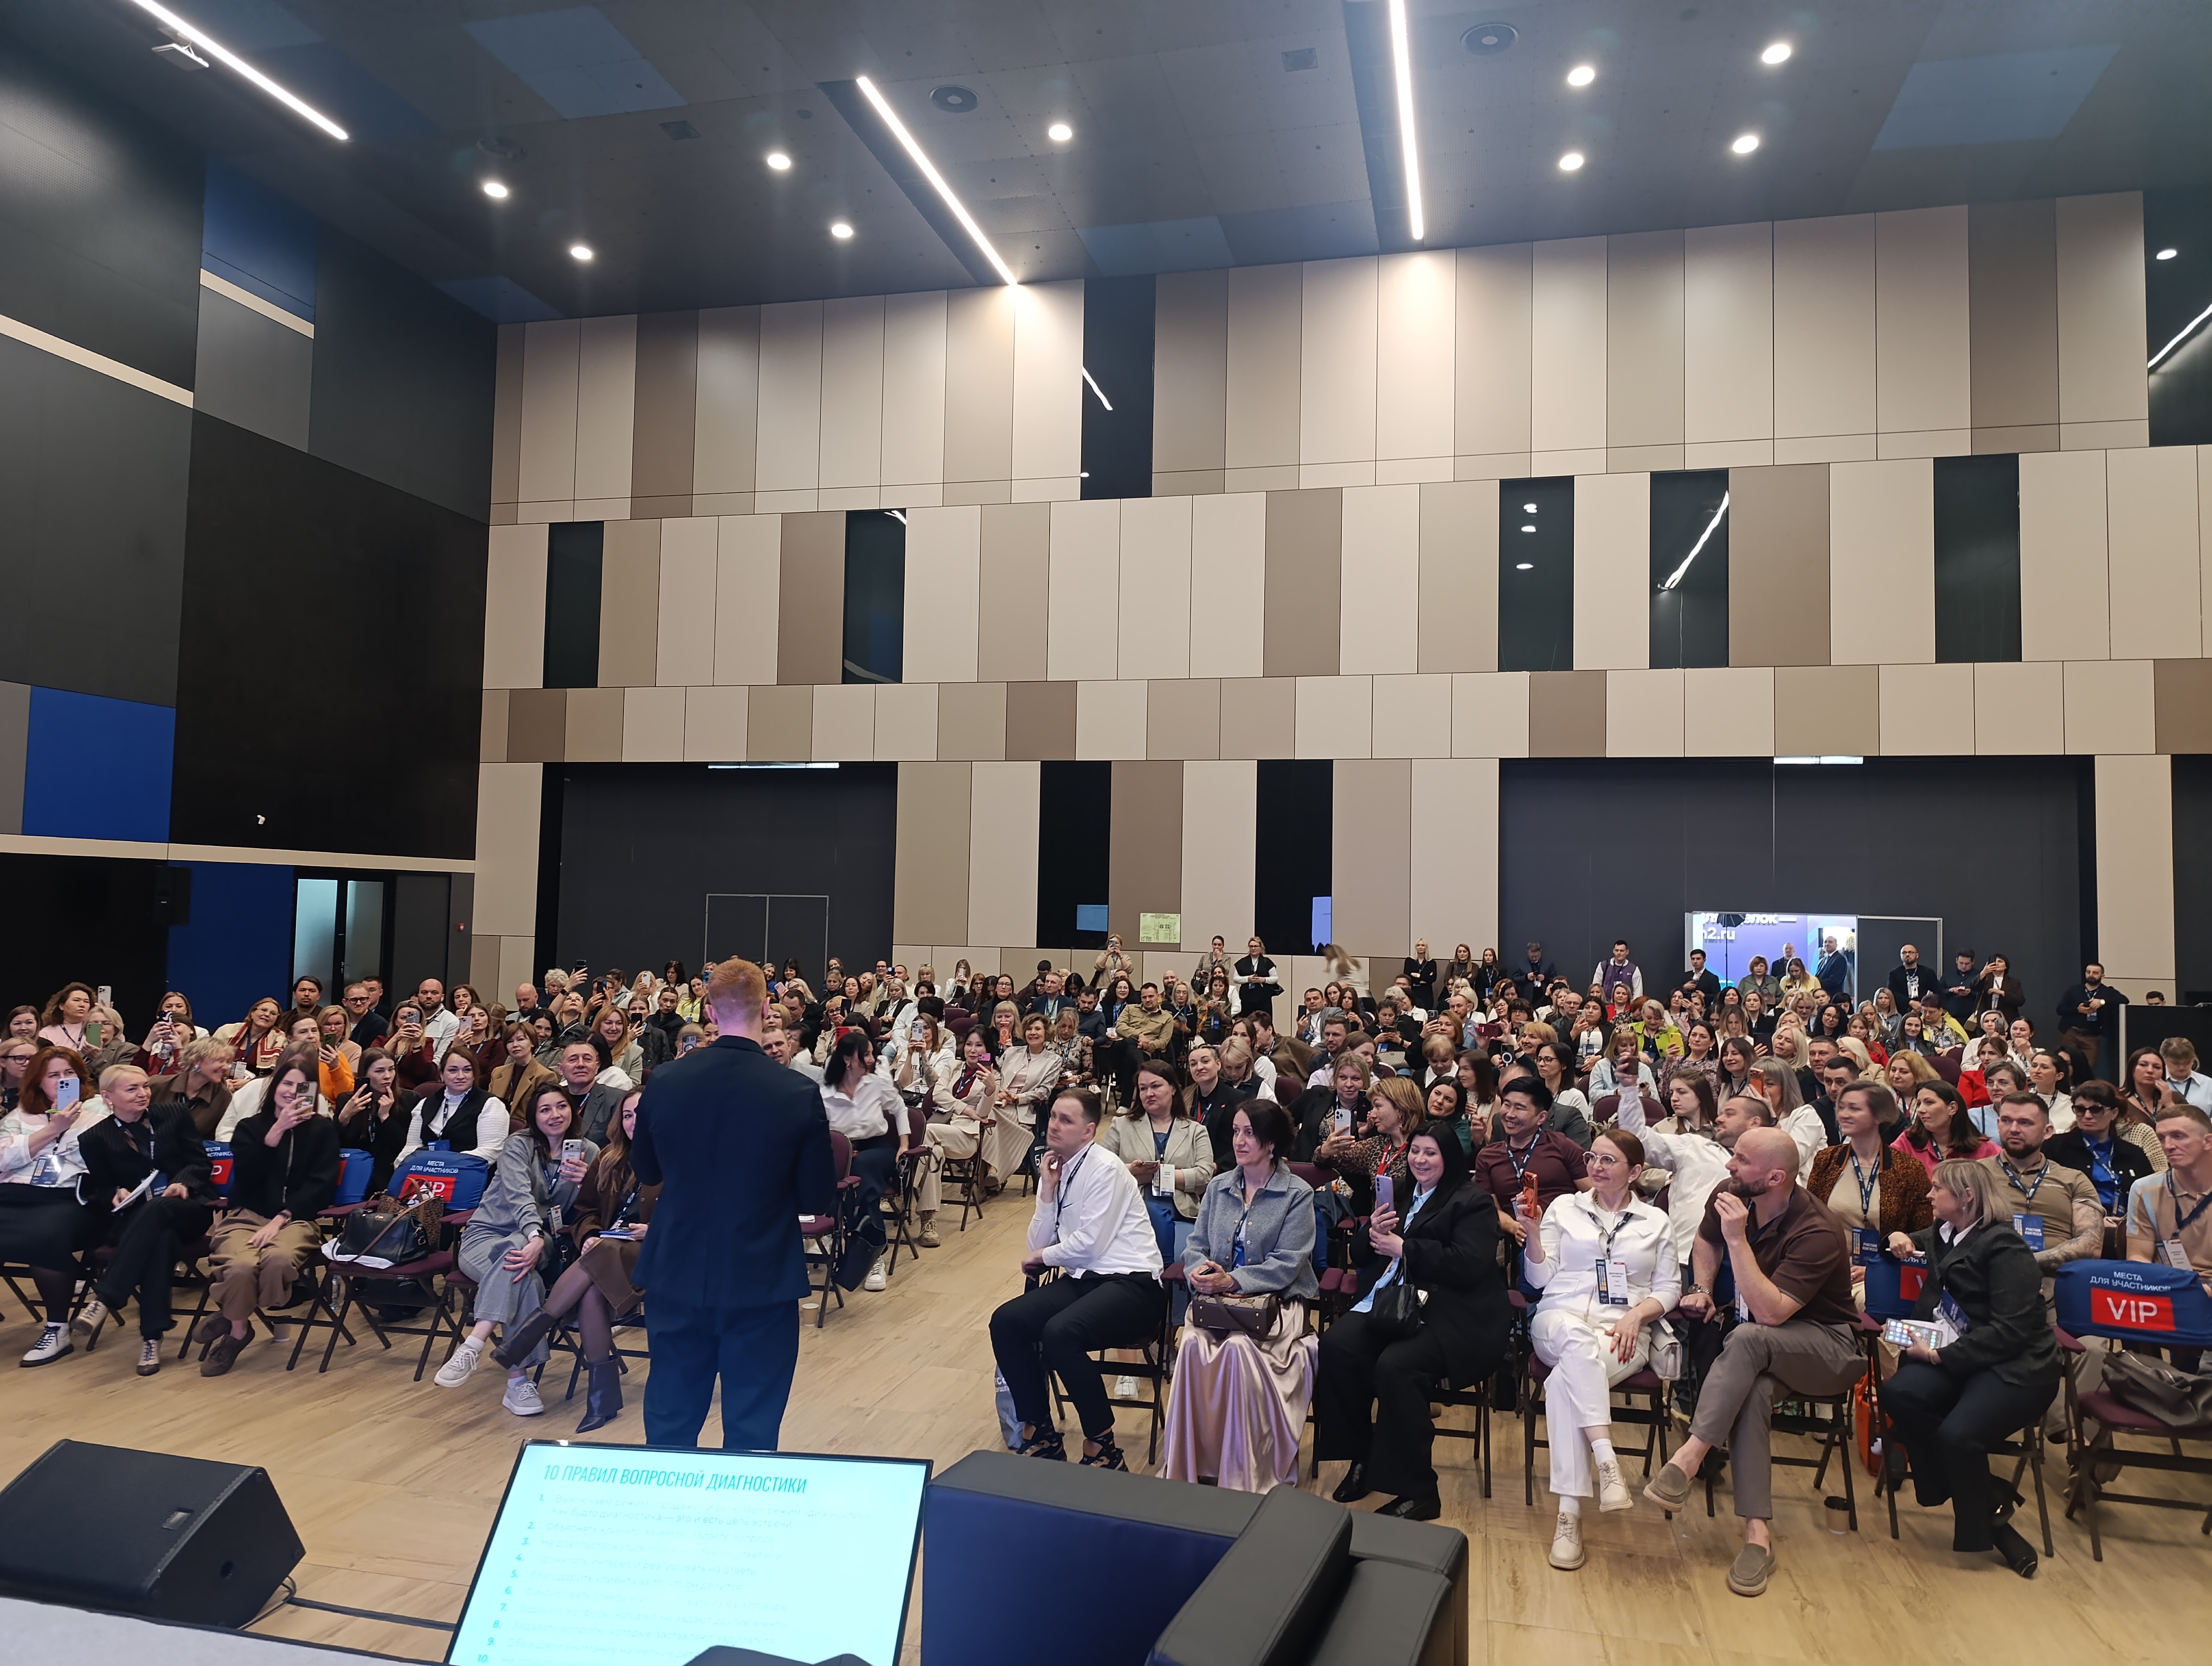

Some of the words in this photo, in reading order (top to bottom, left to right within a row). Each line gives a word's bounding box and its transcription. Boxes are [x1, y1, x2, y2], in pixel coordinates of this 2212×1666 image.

[2090, 1276, 2110, 1285] ДЛЯ
[2113, 1271, 2143, 1282] МЕСТА
[2106, 1297, 2158, 1323] VIP
[544, 1465, 560, 1480] 10
[561, 1465, 618, 1483] ПРАВИЛ
[620, 1469, 705, 1488] ВОПРОСНОЙ
[705, 1473, 807, 1494] ДИАГНОСТИКИ
